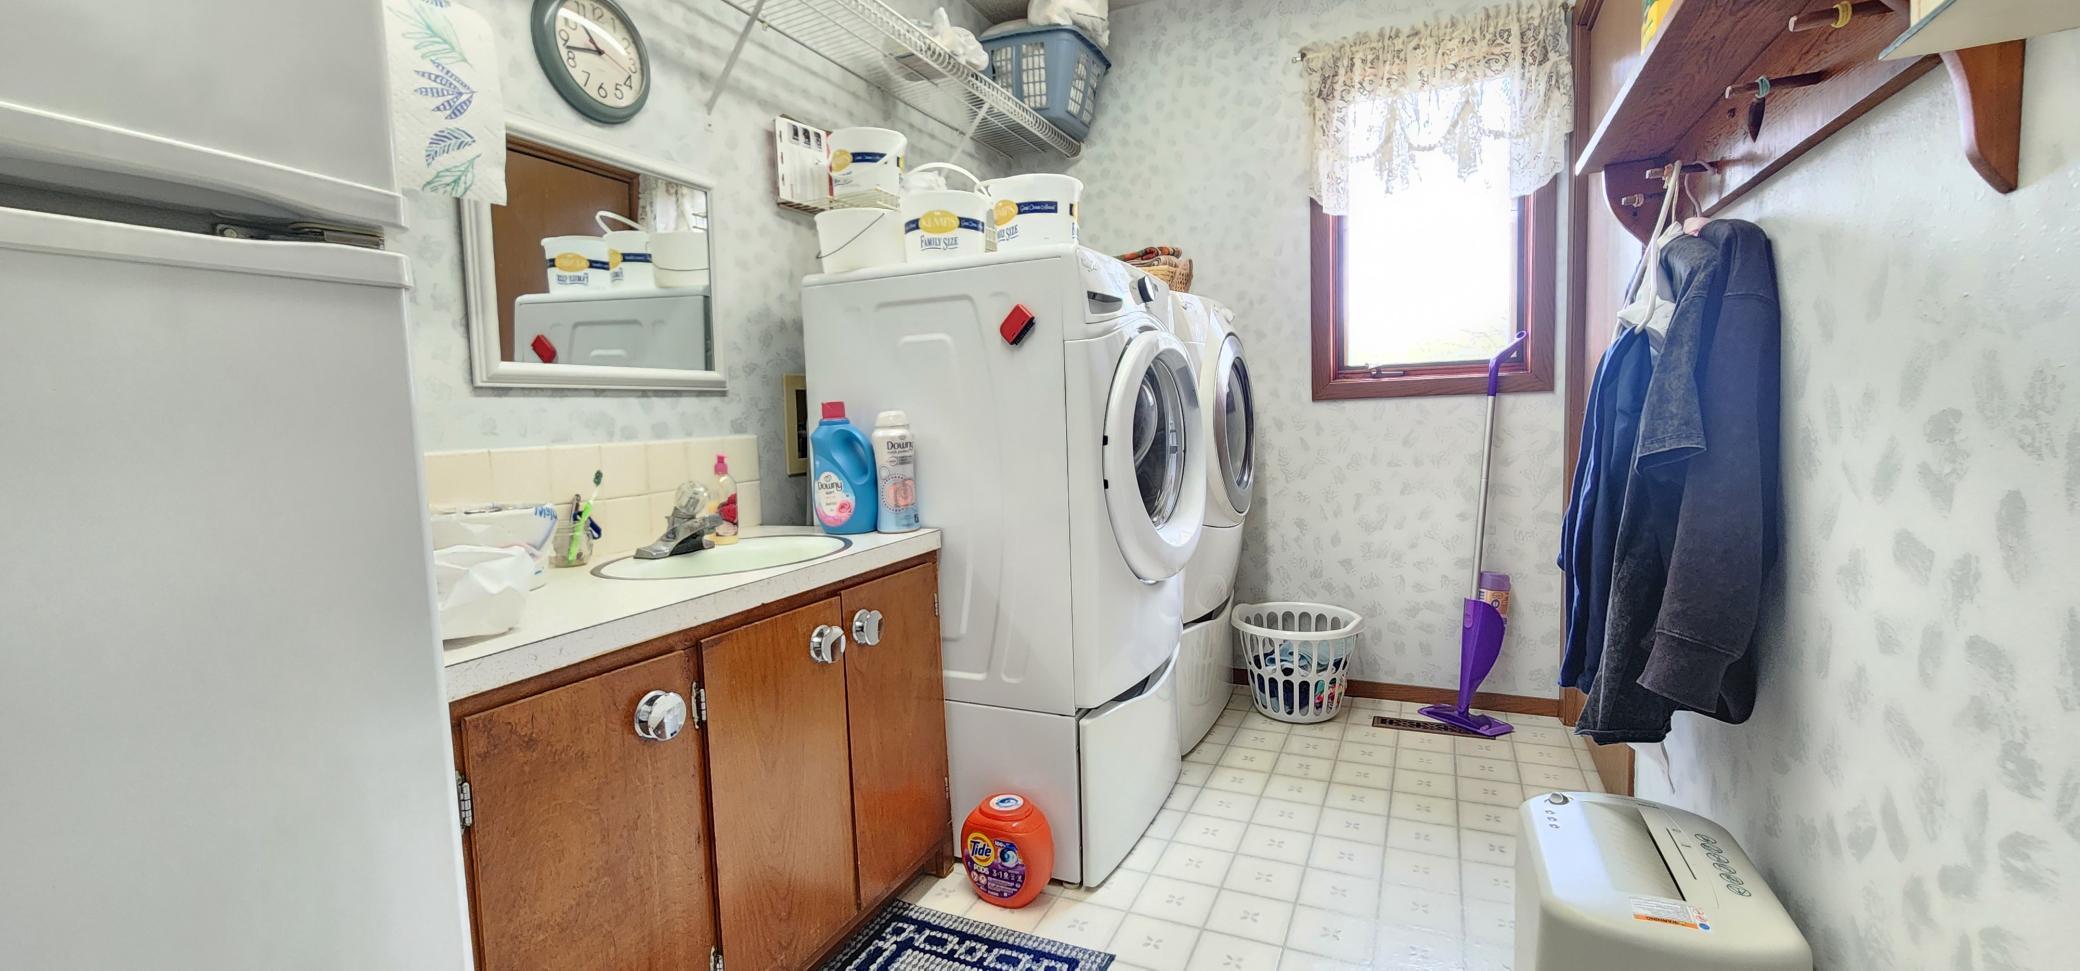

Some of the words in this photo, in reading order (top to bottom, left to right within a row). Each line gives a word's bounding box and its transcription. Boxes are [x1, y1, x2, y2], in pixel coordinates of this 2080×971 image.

[575, 1, 586, 18] 11
[591, 3, 605, 24] 12
[611, 18, 617, 33] 1
[559, 29, 569, 47] 9
[622, 37, 631, 55] 2
[567, 51, 577, 68] 8
[629, 58, 637, 74] 3
[582, 70, 591, 87] 7
[624, 74, 633, 90] 4
[598, 83, 608, 99] 6
[614, 83, 624, 100] 5
[920, 235, 942, 249] FAMILY
[943, 236, 960, 251] SIZE
[817, 481, 843, 492] Downy
[970, 840, 992, 857] Tide
